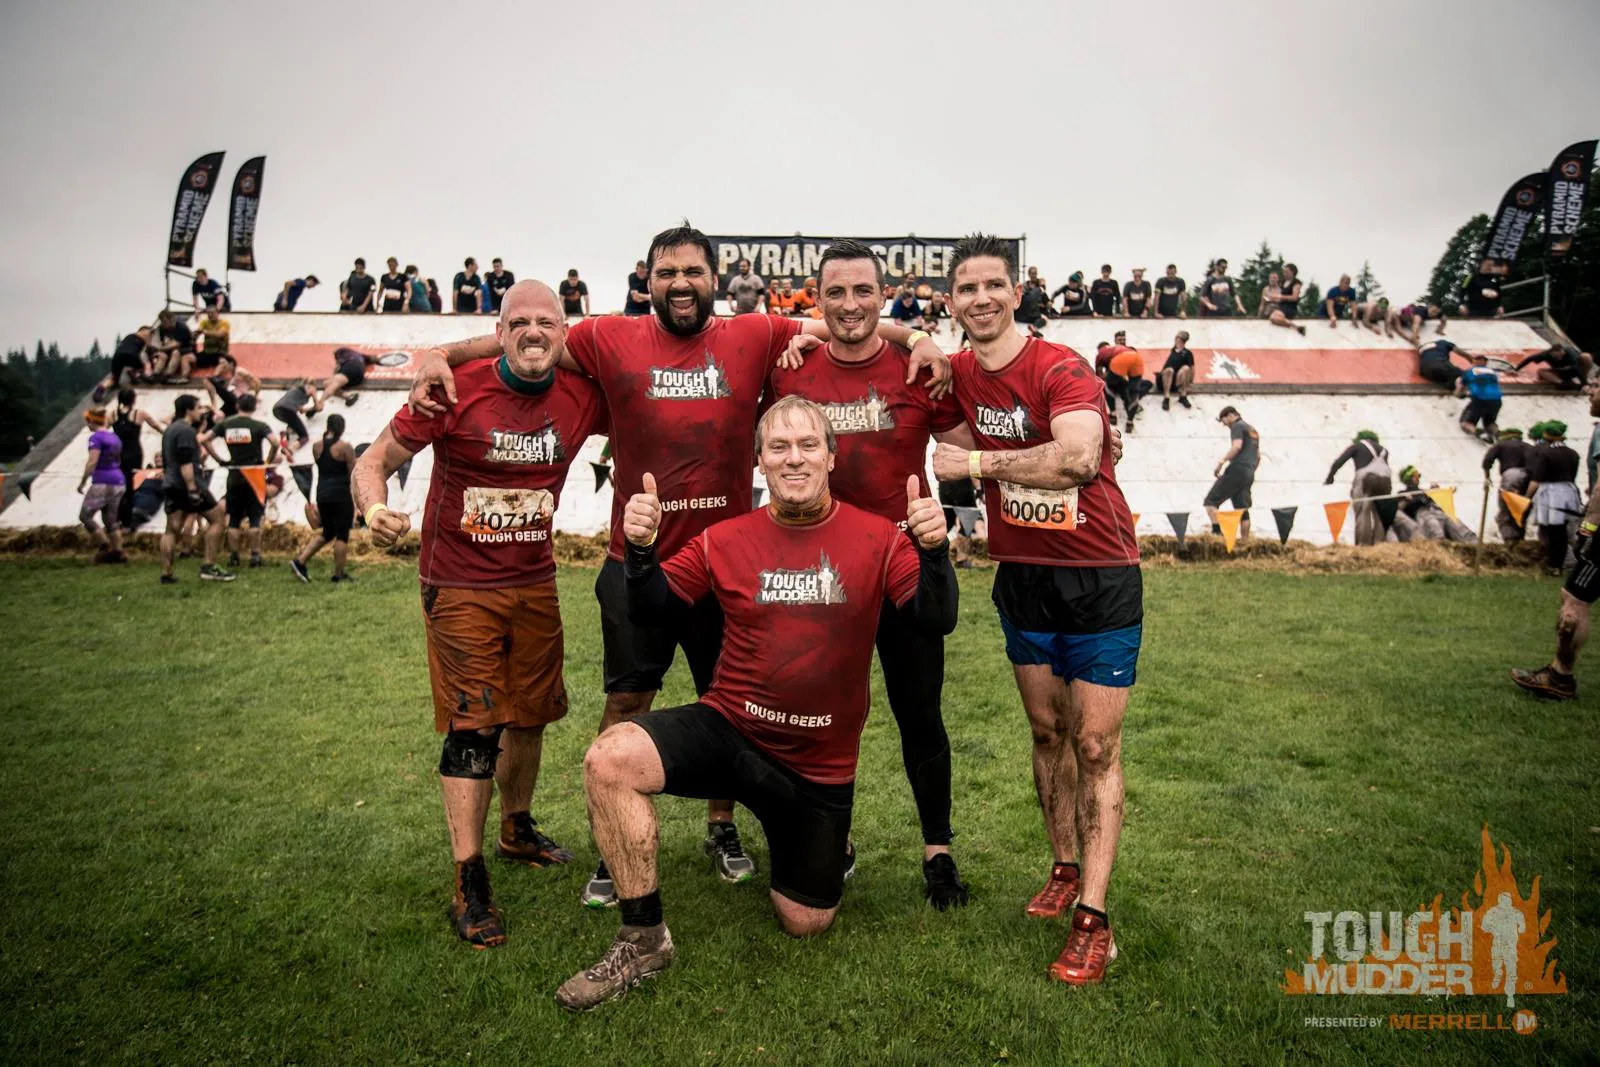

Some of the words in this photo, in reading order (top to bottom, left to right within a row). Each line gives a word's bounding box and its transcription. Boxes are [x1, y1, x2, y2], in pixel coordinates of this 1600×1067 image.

[172, 190, 194, 242] PYRAMID
[184, 191, 209, 243] SCHEME
[1550, 181, 1569, 235] PYRAMID
[1564, 181, 1584, 235] SCHEME
[1487, 206, 1518, 258] PYRAMID
[1502, 209, 1533, 261] SCHEME
[718, 243, 829, 276] PYRAM
[868, 244, 954, 278] SCHE
[653, 369, 704, 387] TOUGH
[653, 386, 707, 398] MUDDER
[831, 419, 868, 431] DDER
[977, 405, 1014, 428] TOUGH
[493, 431, 543, 453] TOUGH
[493, 448, 544, 462] MUDDER
[661, 499, 688, 512] UGH
[689, 495, 727, 509] GEEKS
[1002, 498, 1066, 524] 40005
[472, 531, 512, 543] TOUGH
[515, 530, 547, 542] GEEKS
[763, 573, 818, 591] TOUGH
[762, 589, 819, 601] MUDDER
[745, 701, 786, 724] TOUGH
[789, 714, 832, 728] GEEKS
